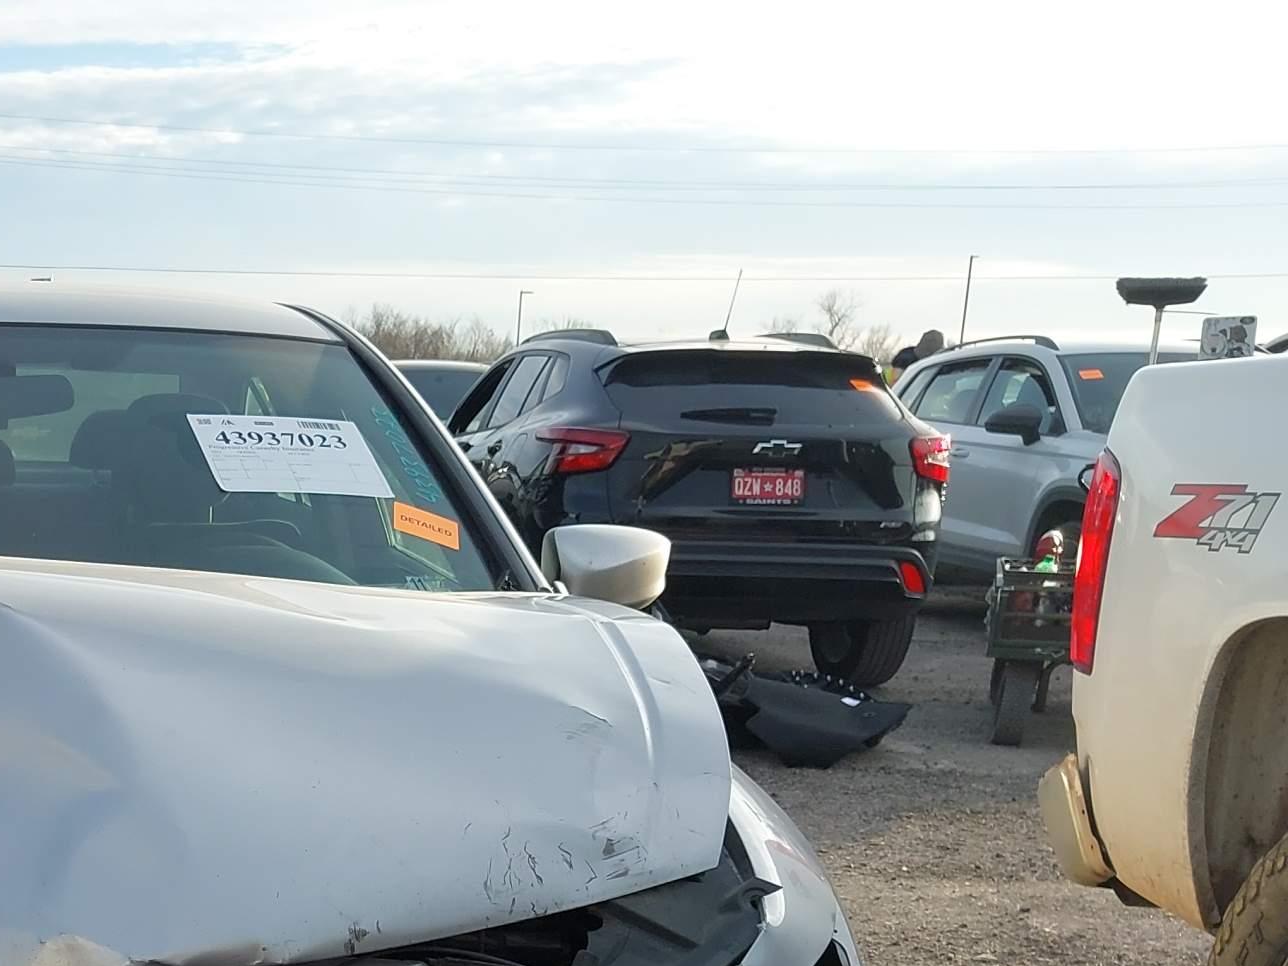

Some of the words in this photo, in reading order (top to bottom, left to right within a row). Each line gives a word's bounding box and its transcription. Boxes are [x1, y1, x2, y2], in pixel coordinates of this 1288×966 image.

[215, 430, 347, 449] 43937023
[775, 478, 801, 497] 848
[1153, 483, 1282, 539] Z71
[400, 514, 453, 537] DETAILED
